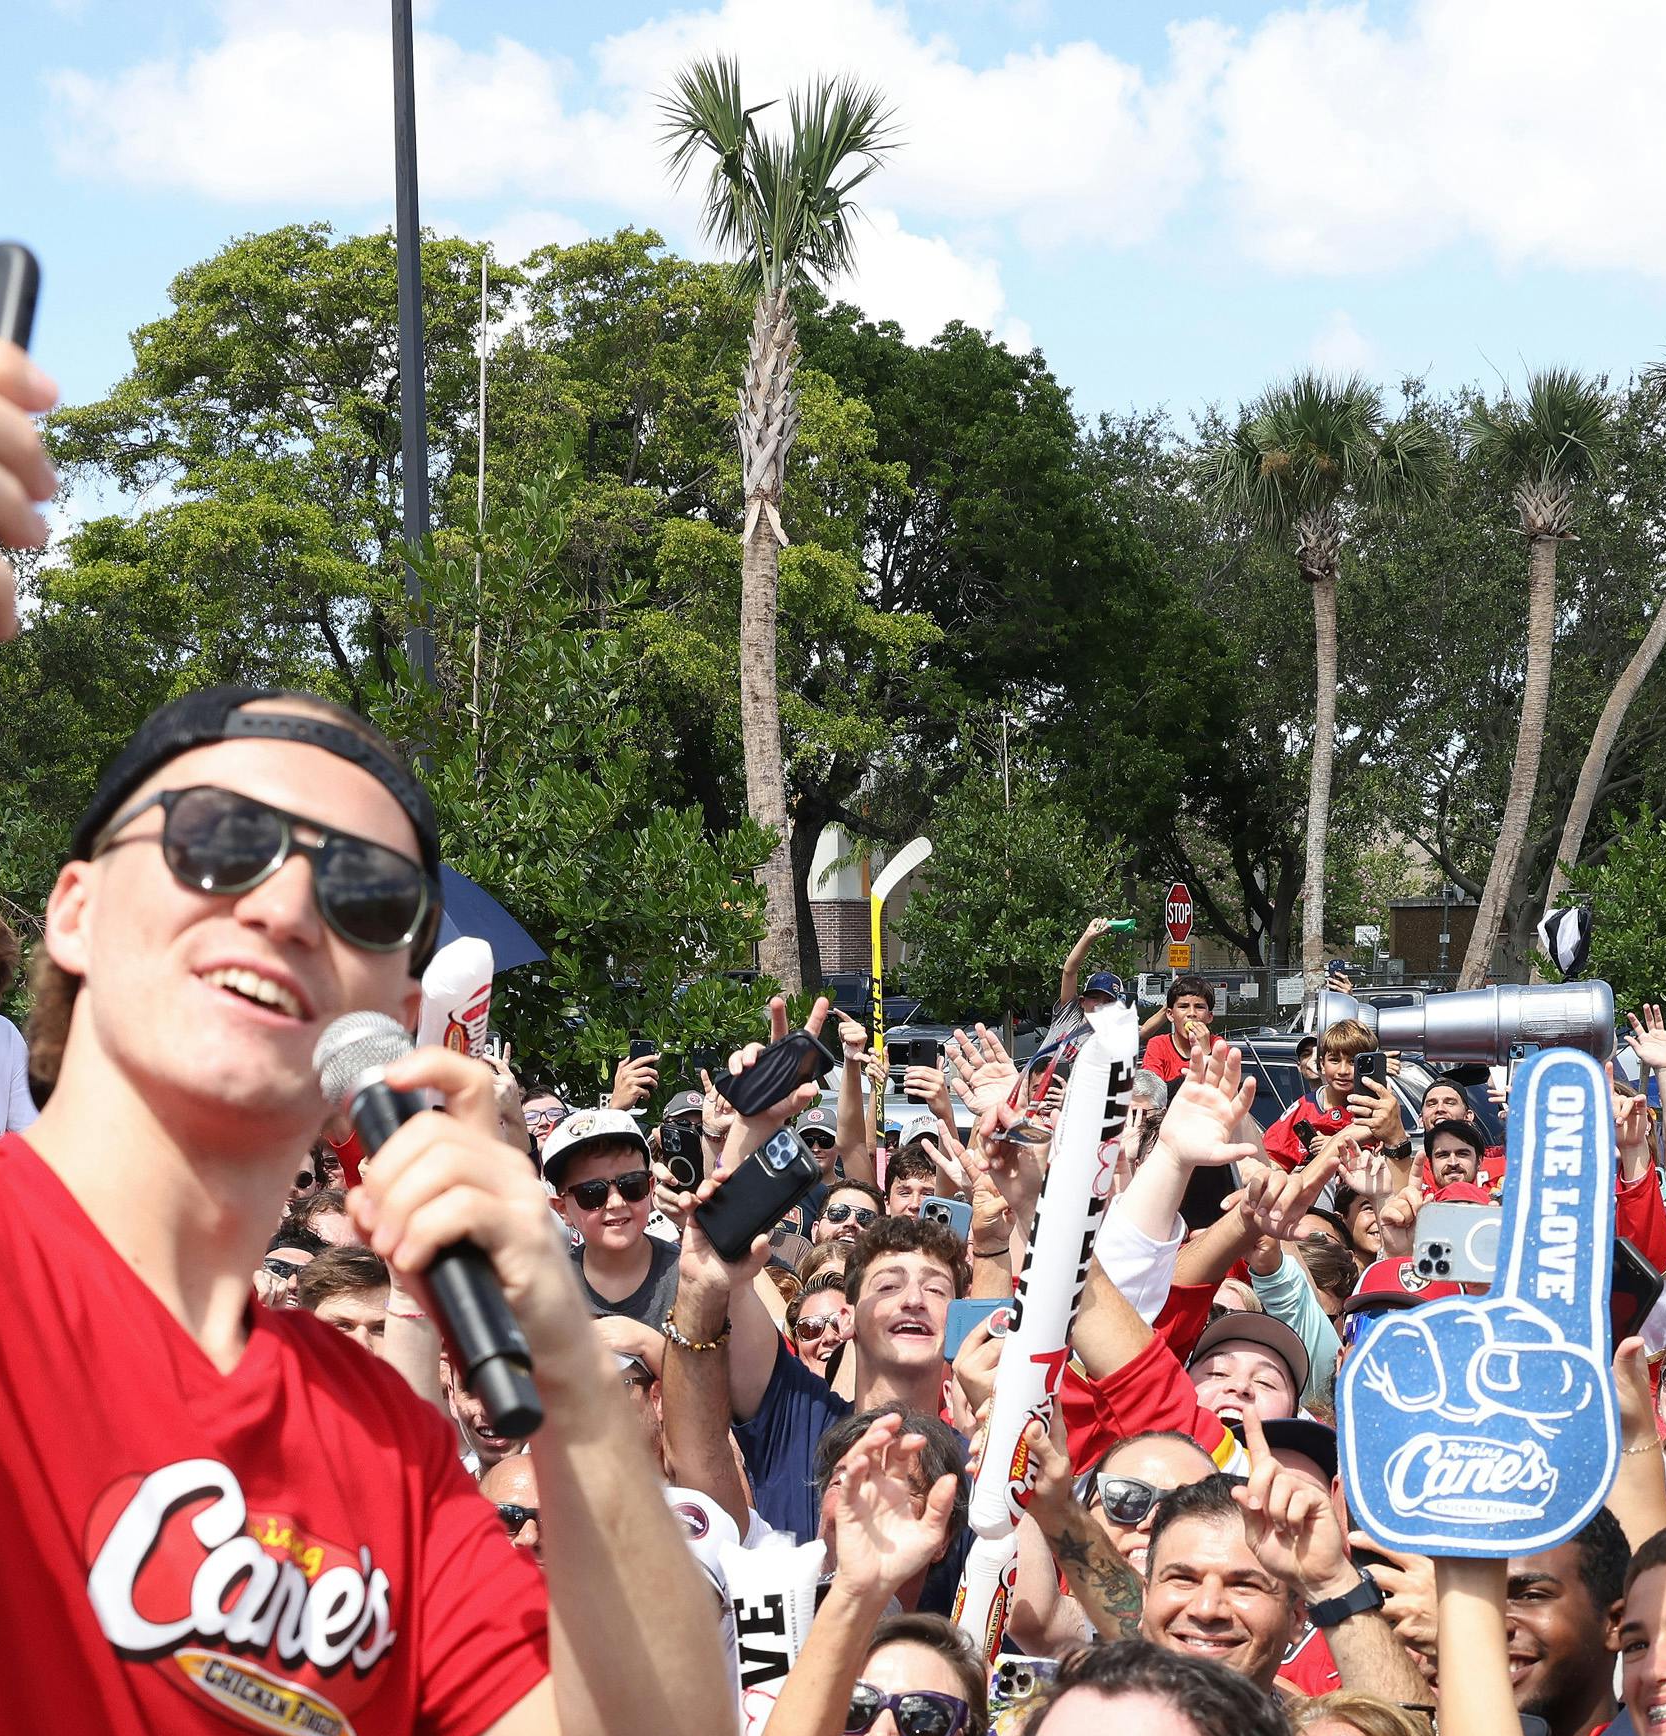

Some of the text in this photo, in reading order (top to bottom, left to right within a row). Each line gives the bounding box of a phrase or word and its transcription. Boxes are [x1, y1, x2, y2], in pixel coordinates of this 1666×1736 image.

[1168, 902, 1191, 924] STOP
[1537, 1086, 1584, 1306] ONE LOVE
[1395, 1438, 1551, 1508] Cane's
[1444, 1442, 1505, 1460] Raising
[1436, 1502, 1534, 1517] CHICKEN FINGERS
[88, 1457, 396, 1669] Cane's
[993, 1595, 1004, 1628] CHICKEN
[202, 1660, 288, 1717] CHICKEN
